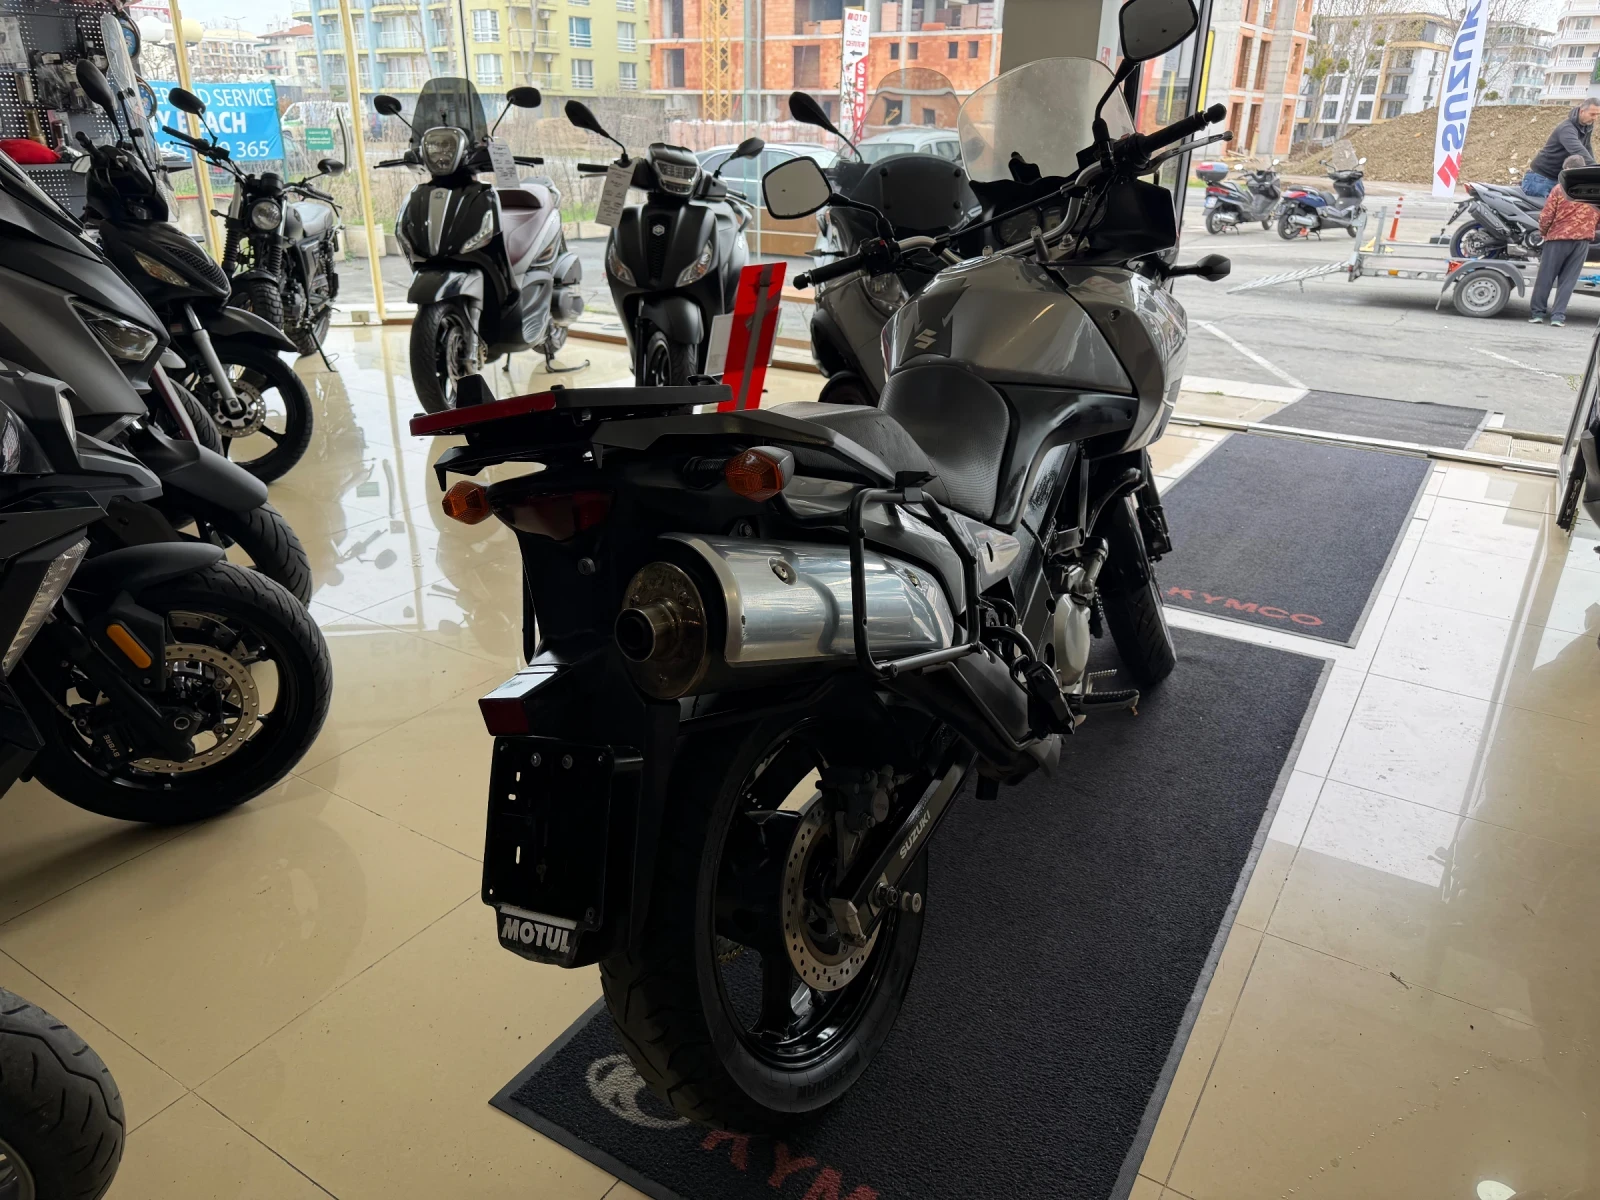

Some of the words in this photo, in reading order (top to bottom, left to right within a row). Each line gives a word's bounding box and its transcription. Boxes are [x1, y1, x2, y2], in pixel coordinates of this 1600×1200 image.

[213, 88, 275, 107] SERVICE
[236, 141, 270, 158] 365
[1167, 586, 1324, 627] KYMCO
[103, 734, 120, 757] BYBRE
[900, 809, 931, 860] SUZUKI
[501, 917, 571, 954] MOTUL
